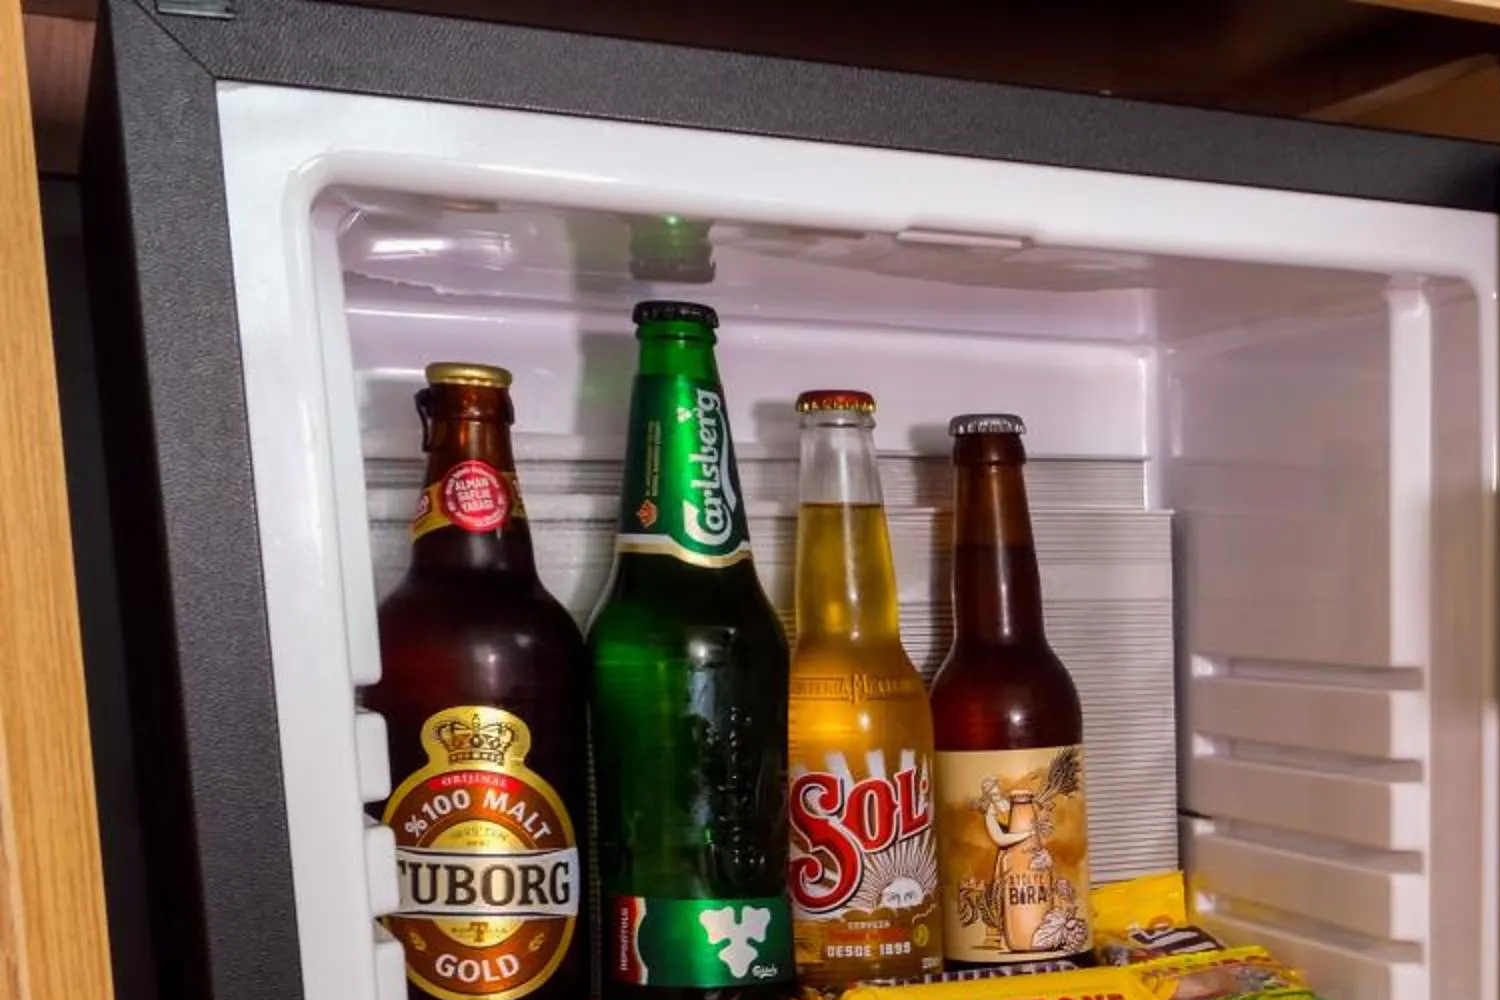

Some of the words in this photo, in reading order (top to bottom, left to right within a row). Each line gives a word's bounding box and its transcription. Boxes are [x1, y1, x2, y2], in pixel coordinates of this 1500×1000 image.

[684, 389, 735, 547] Carlsberg
[404, 788, 471, 838] %100
[482, 787, 552, 841] MALT
[435, 952, 520, 984] GOLD
[826, 944, 873, 957] DESDE
